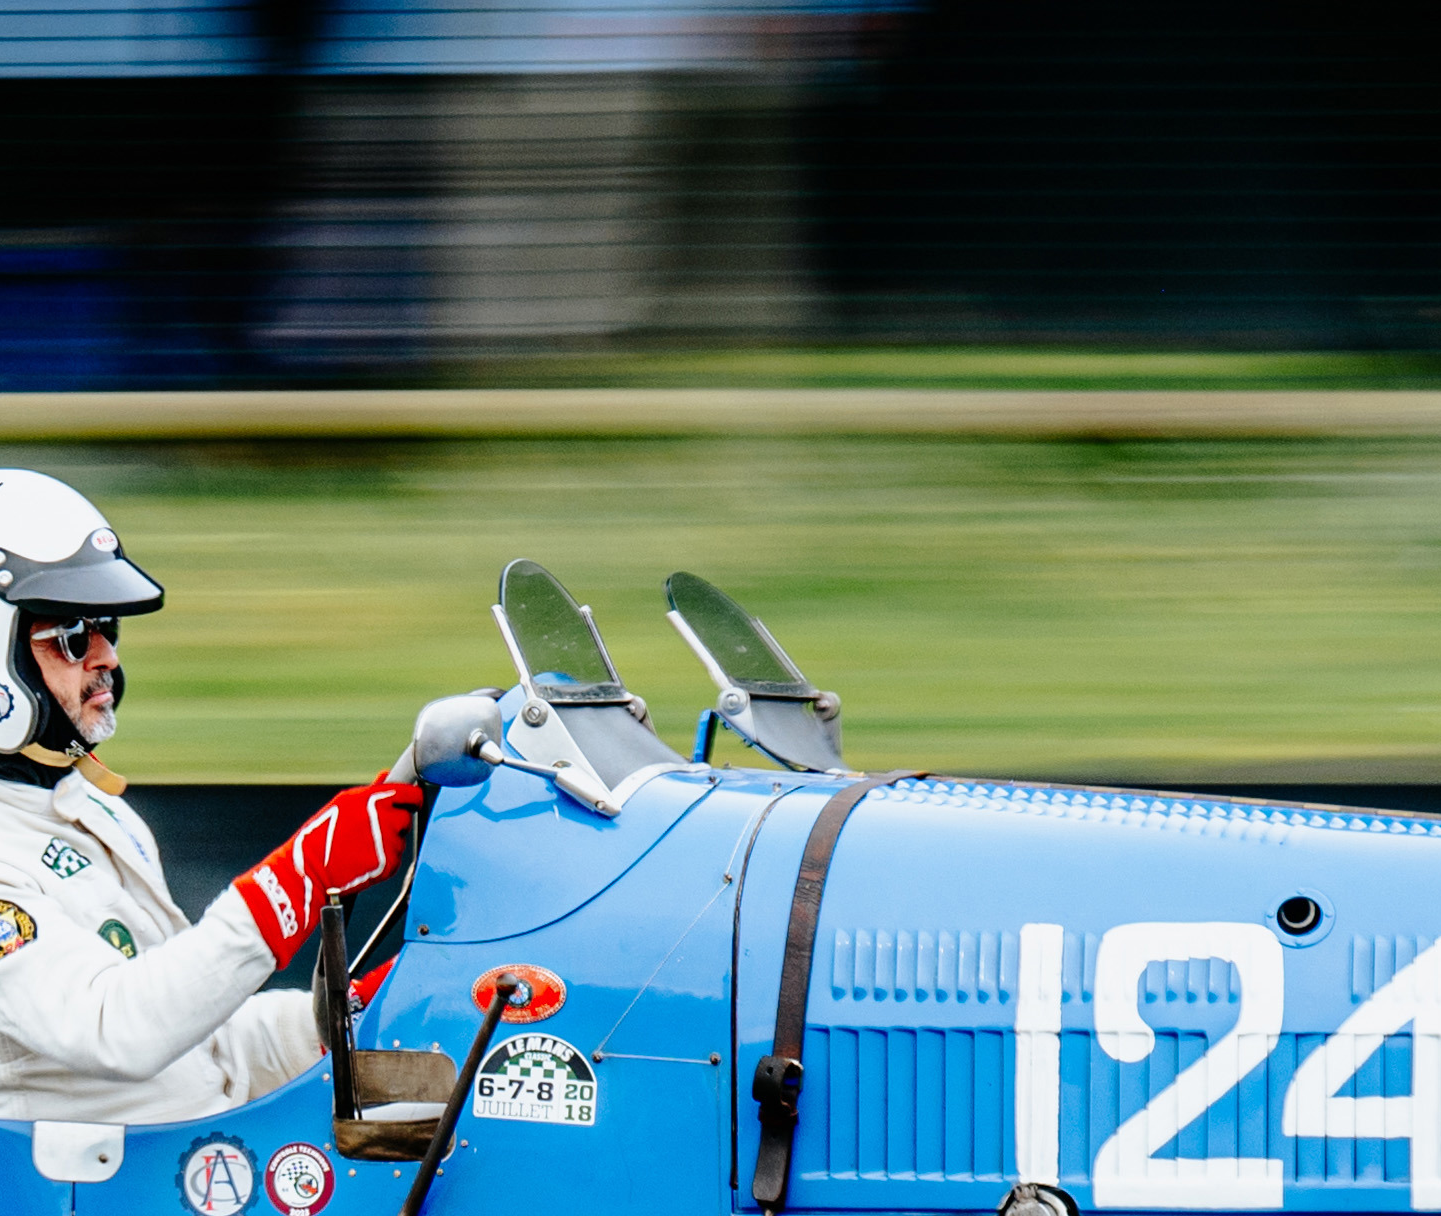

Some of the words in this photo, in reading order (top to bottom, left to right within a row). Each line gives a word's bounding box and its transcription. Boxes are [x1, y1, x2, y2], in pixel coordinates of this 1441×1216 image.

[478, 1077, 553, 1101] 6-7-8
[564, 1084, 594, 1101] 20
[476, 1100, 553, 1119] JUILLET
[564, 1104, 592, 1121] 18
